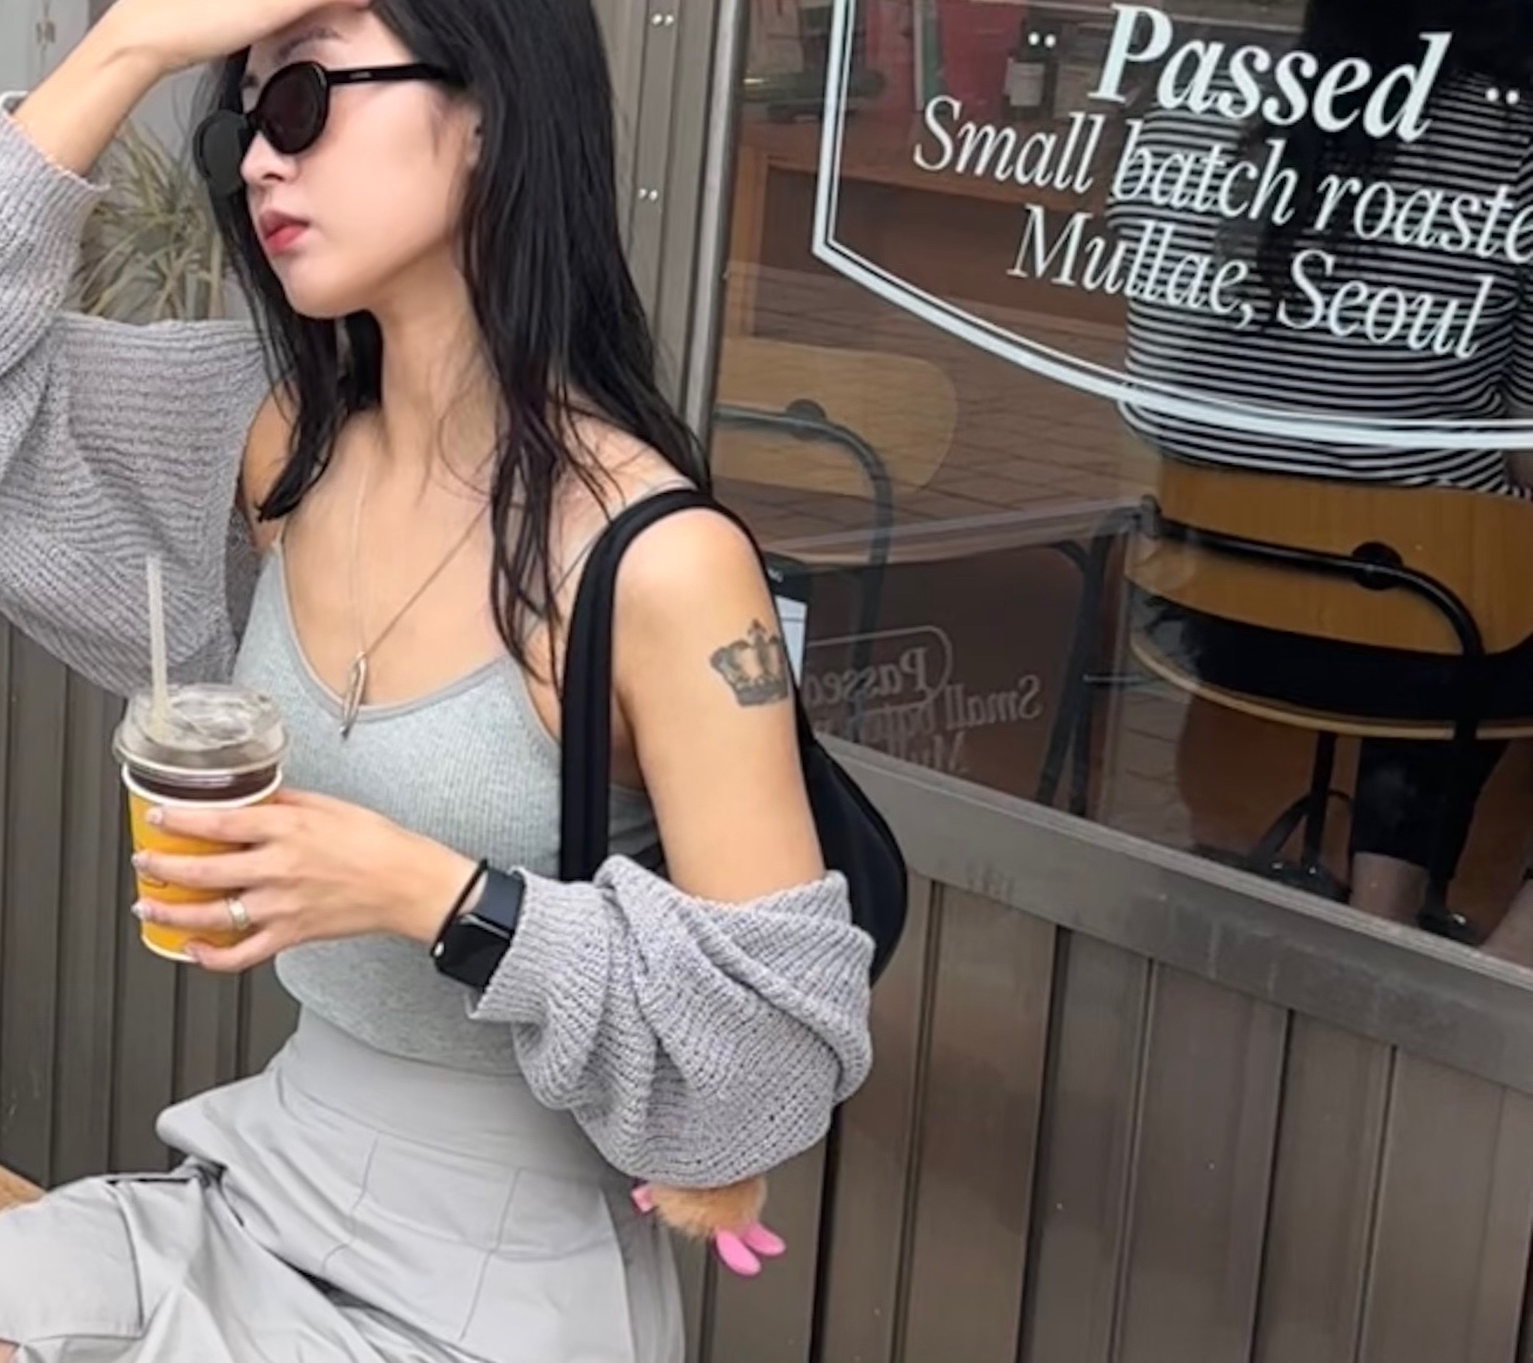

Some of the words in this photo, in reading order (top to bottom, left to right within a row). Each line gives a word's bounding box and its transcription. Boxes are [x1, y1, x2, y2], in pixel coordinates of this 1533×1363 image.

[1088, 1, 1453, 143] Passed
[913, 94, 1103, 195] Small
[1112, 119, 1299, 227] batch
[1007, 203, 1257, 333] Mullae,
[1276, 248, 1495, 360] Seoul
